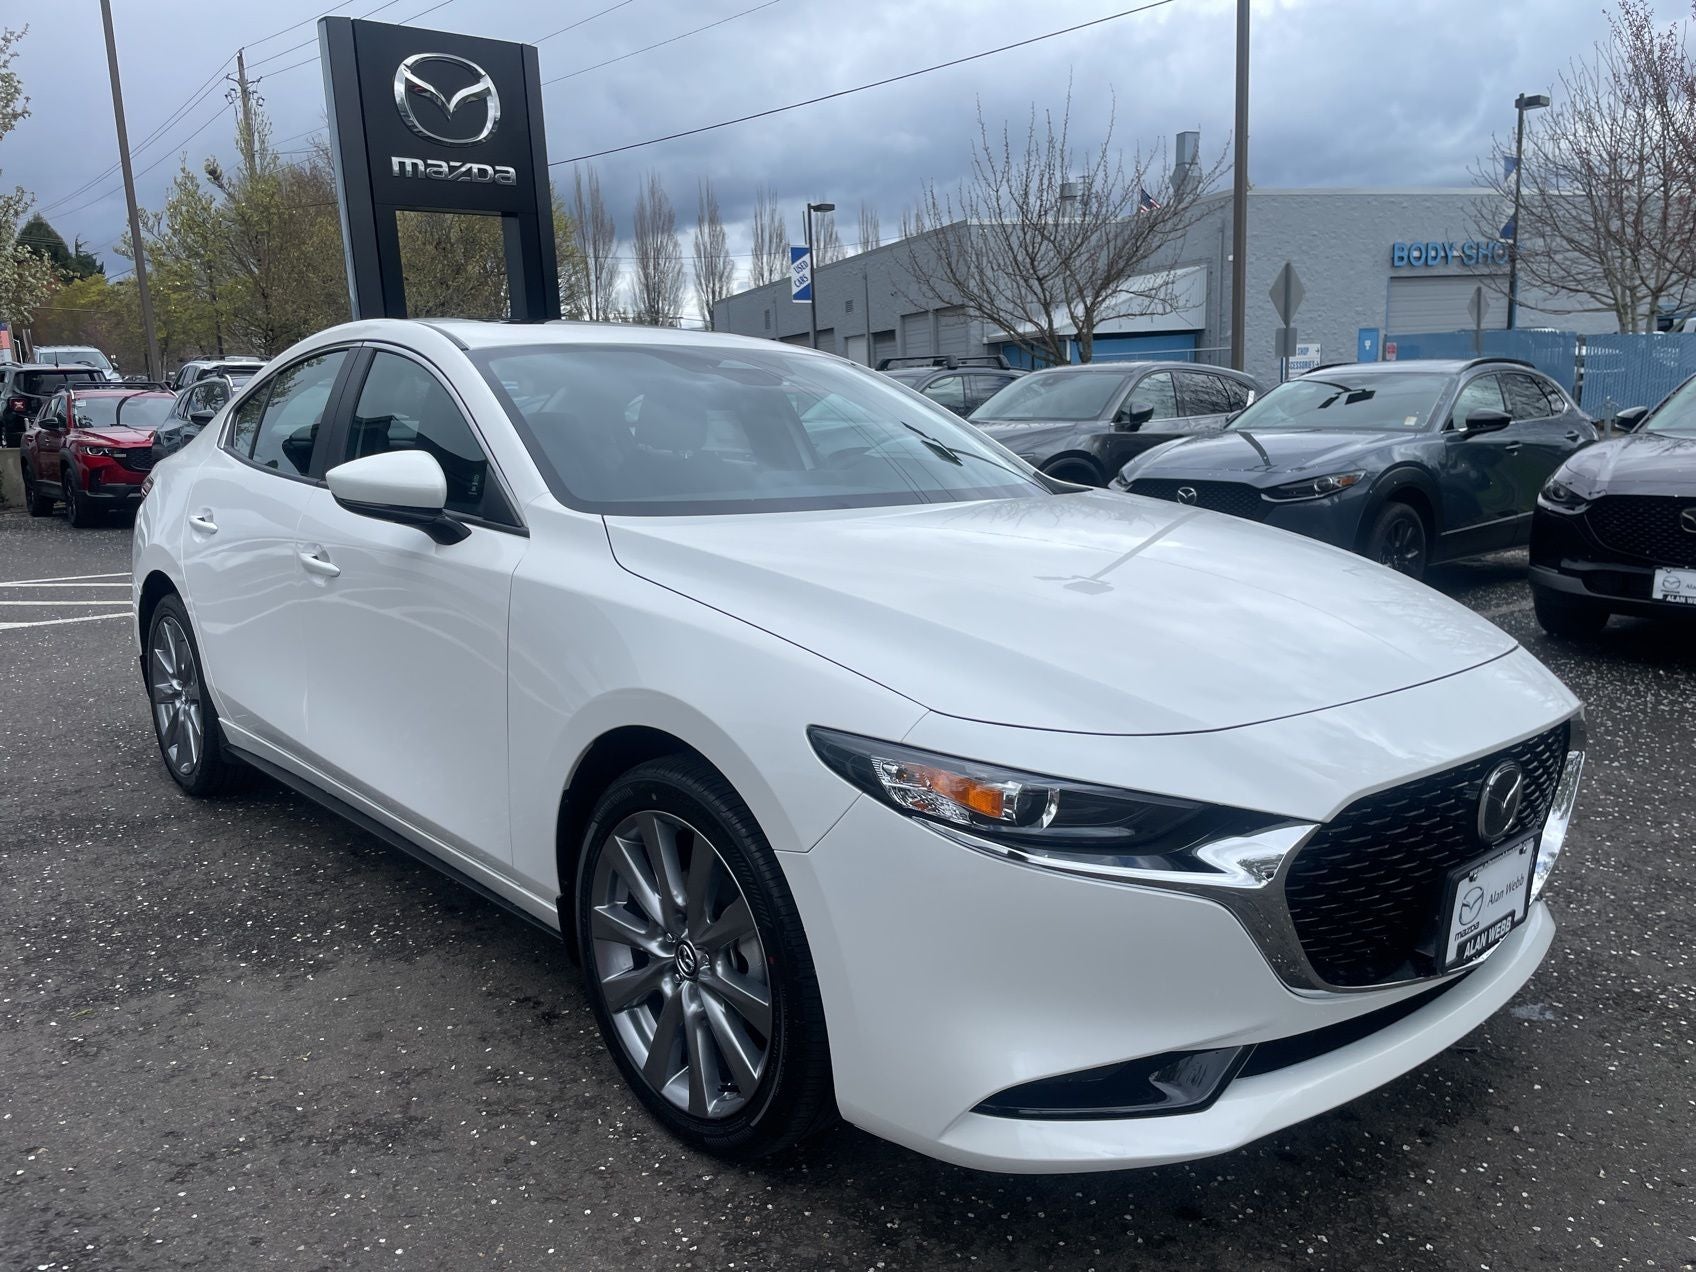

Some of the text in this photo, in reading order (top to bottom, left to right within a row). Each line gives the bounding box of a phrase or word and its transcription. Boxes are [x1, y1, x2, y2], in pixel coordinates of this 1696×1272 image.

[1392, 239, 1511, 268] BODY SHO
[793, 260, 809, 274] USED
[793, 274, 809, 288] CARS
[1297, 346, 1309, 356] SHOP
[1487, 873, 1525, 908] Alan Webb
[1463, 915, 1513, 960] ALAN WEBB
